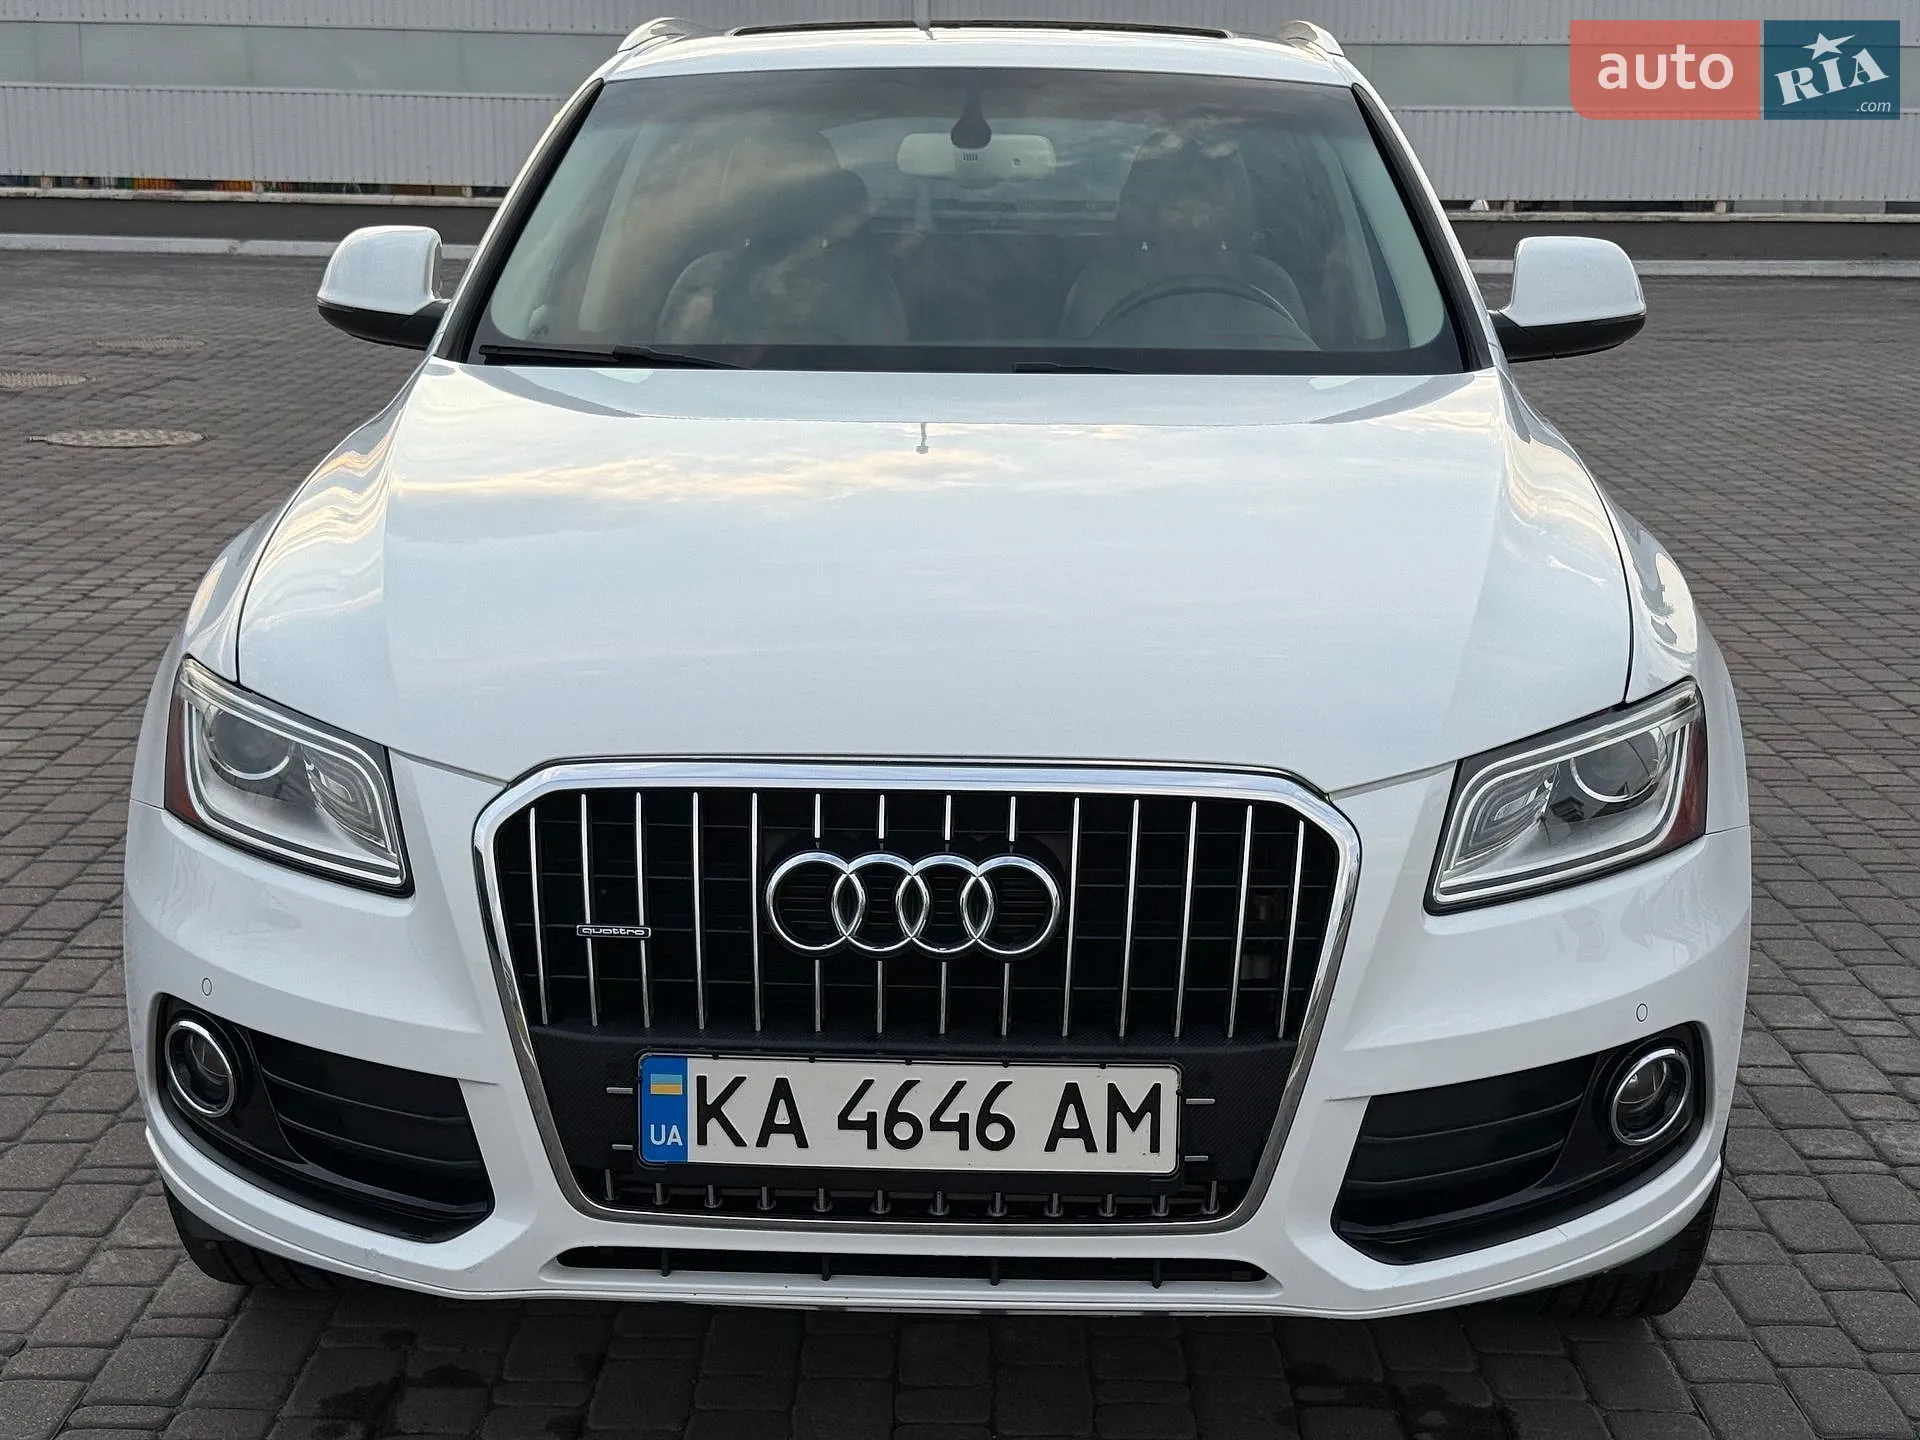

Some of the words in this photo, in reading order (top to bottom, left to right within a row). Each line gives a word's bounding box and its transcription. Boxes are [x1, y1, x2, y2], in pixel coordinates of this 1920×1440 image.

[582, 927, 645, 936] quattro
[695, 1074, 810, 1149] KA
[837, 1078, 1016, 1151] 4646
[1043, 1081, 1162, 1154] AM
[650, 1124, 683, 1147] UA
